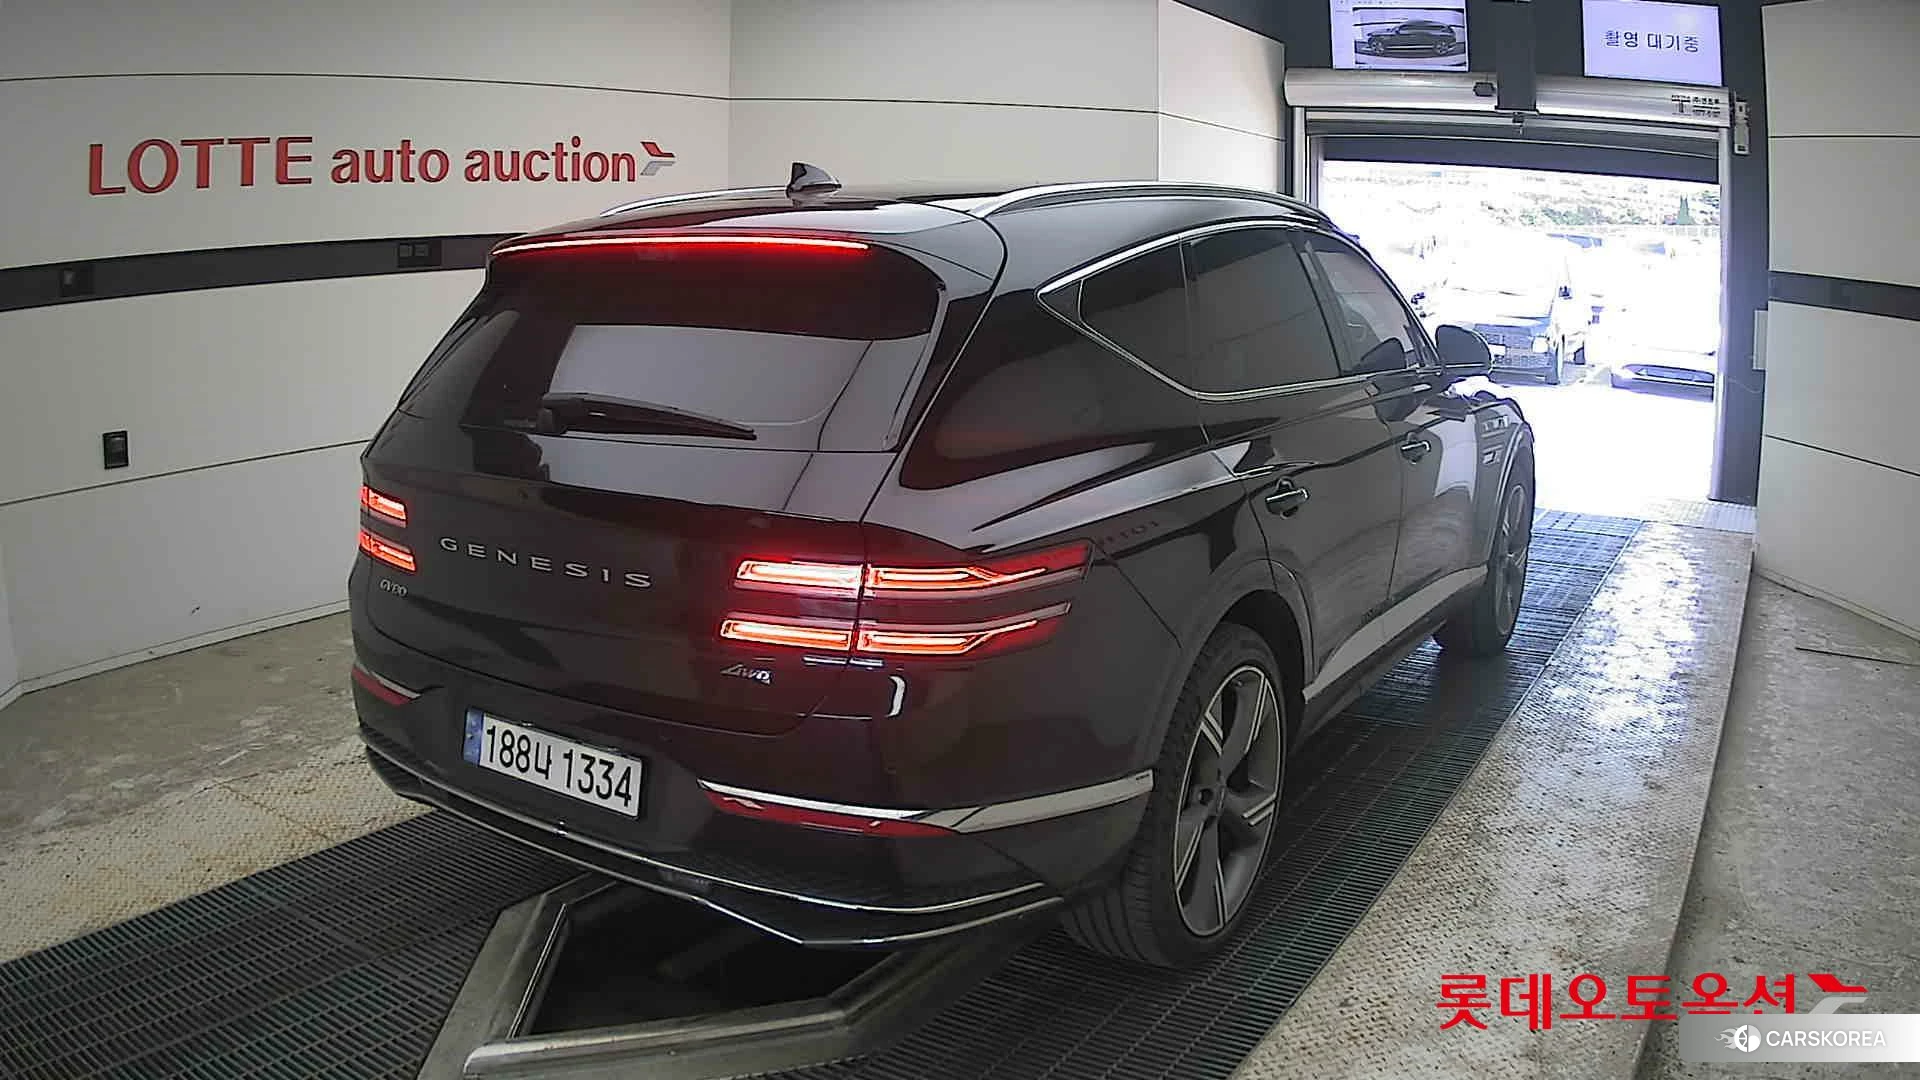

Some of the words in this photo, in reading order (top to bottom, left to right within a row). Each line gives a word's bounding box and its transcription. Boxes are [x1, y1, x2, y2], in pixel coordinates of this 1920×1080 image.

[1604, 30, 1639, 48] 촬영
[1646, 32, 1699, 53] 대기중
[88, 136, 313, 196] LOTTE
[330, 138, 450, 184] auto
[464, 135, 637, 183] auction
[440, 537, 652, 588] GENESIS
[562, 748, 632, 808] 1334
